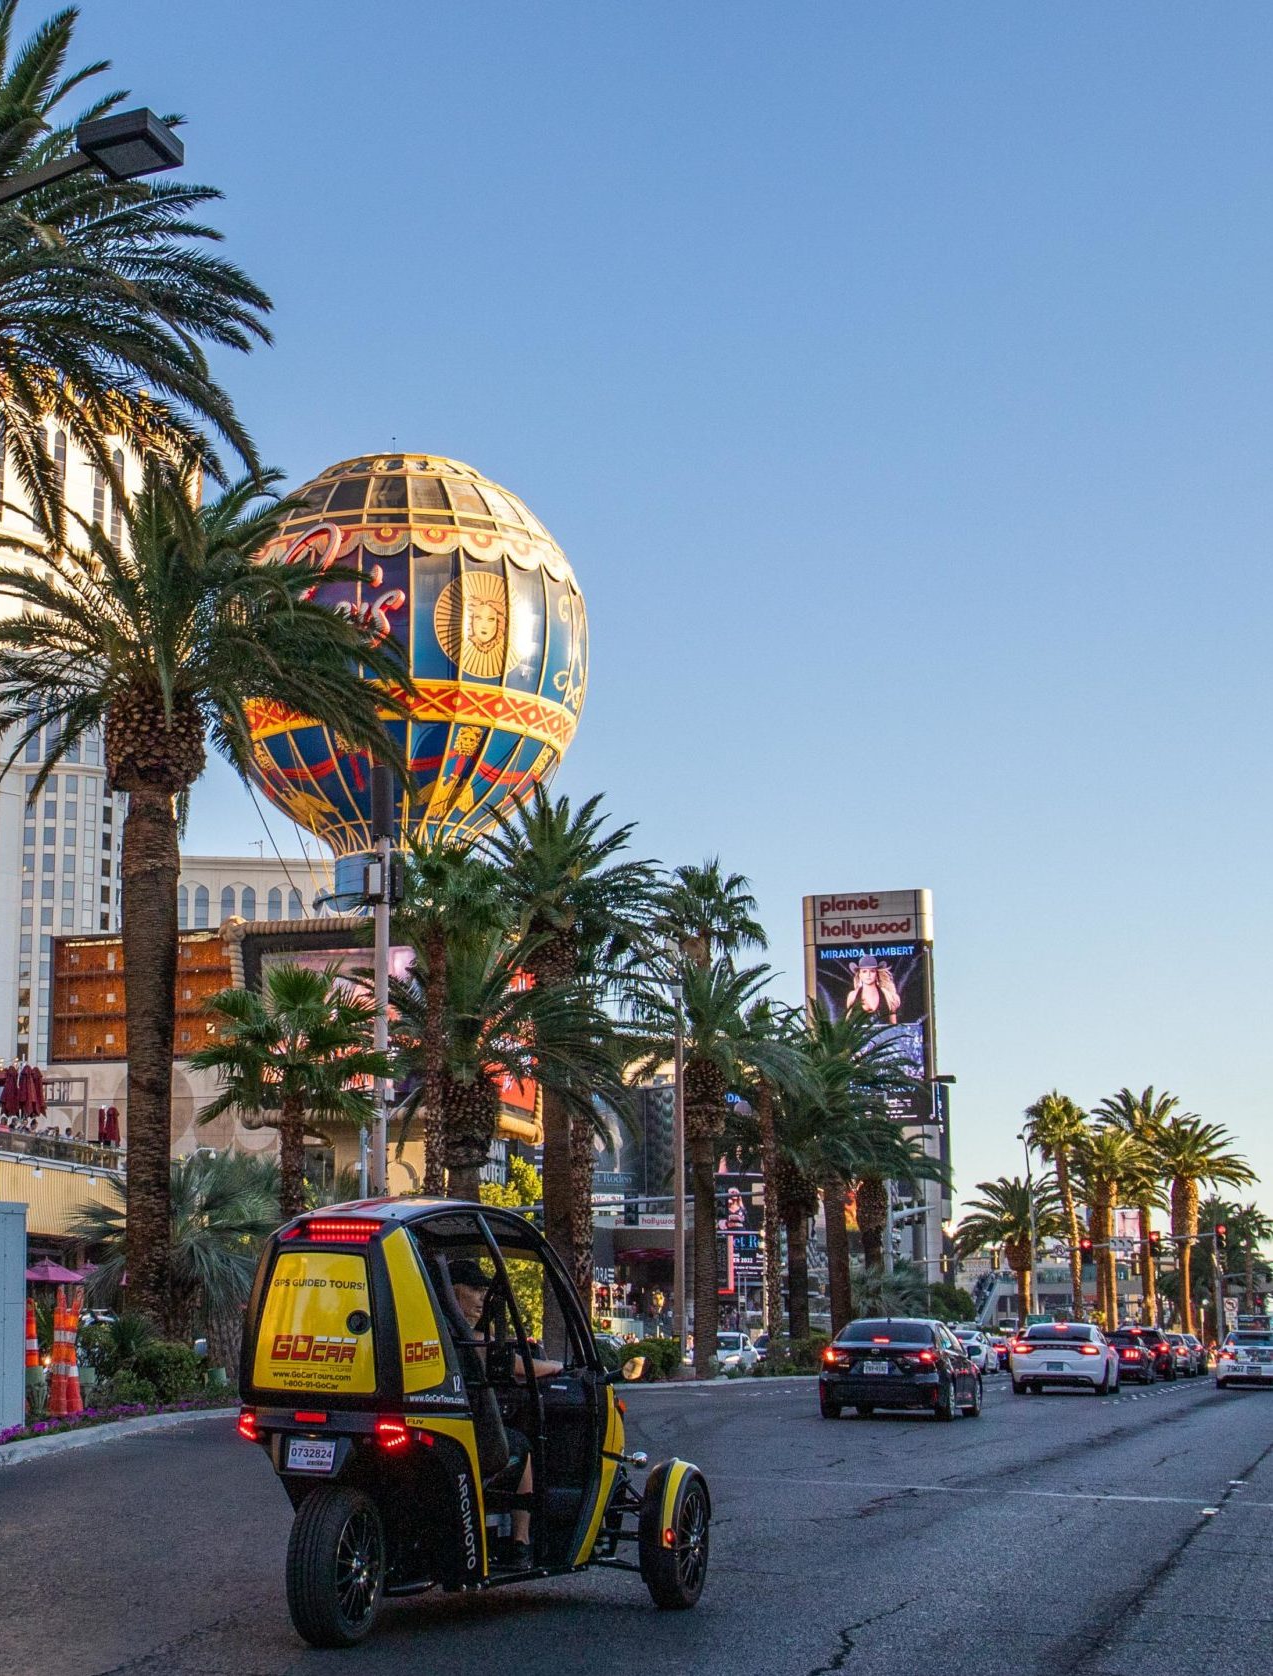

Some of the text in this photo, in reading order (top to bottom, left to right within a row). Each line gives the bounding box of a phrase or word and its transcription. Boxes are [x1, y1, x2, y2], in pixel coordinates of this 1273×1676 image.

[820, 895, 879, 916] planet
[821, 918, 911, 939] hollywood
[820, 946, 915, 959] MIRANDA LAMBERT
[274, 1278, 365, 1291] GPS GUIDED TOURS!
[273, 1370, 351, 1381] www.GoCarTours.com
[453, 1375, 462, 1393] 12
[409, 1394, 465, 1404] www.GoCarTours.com
[291, 1447, 332, 1459] 0732824
[458, 1473, 476, 1570] ARCIMOTO
